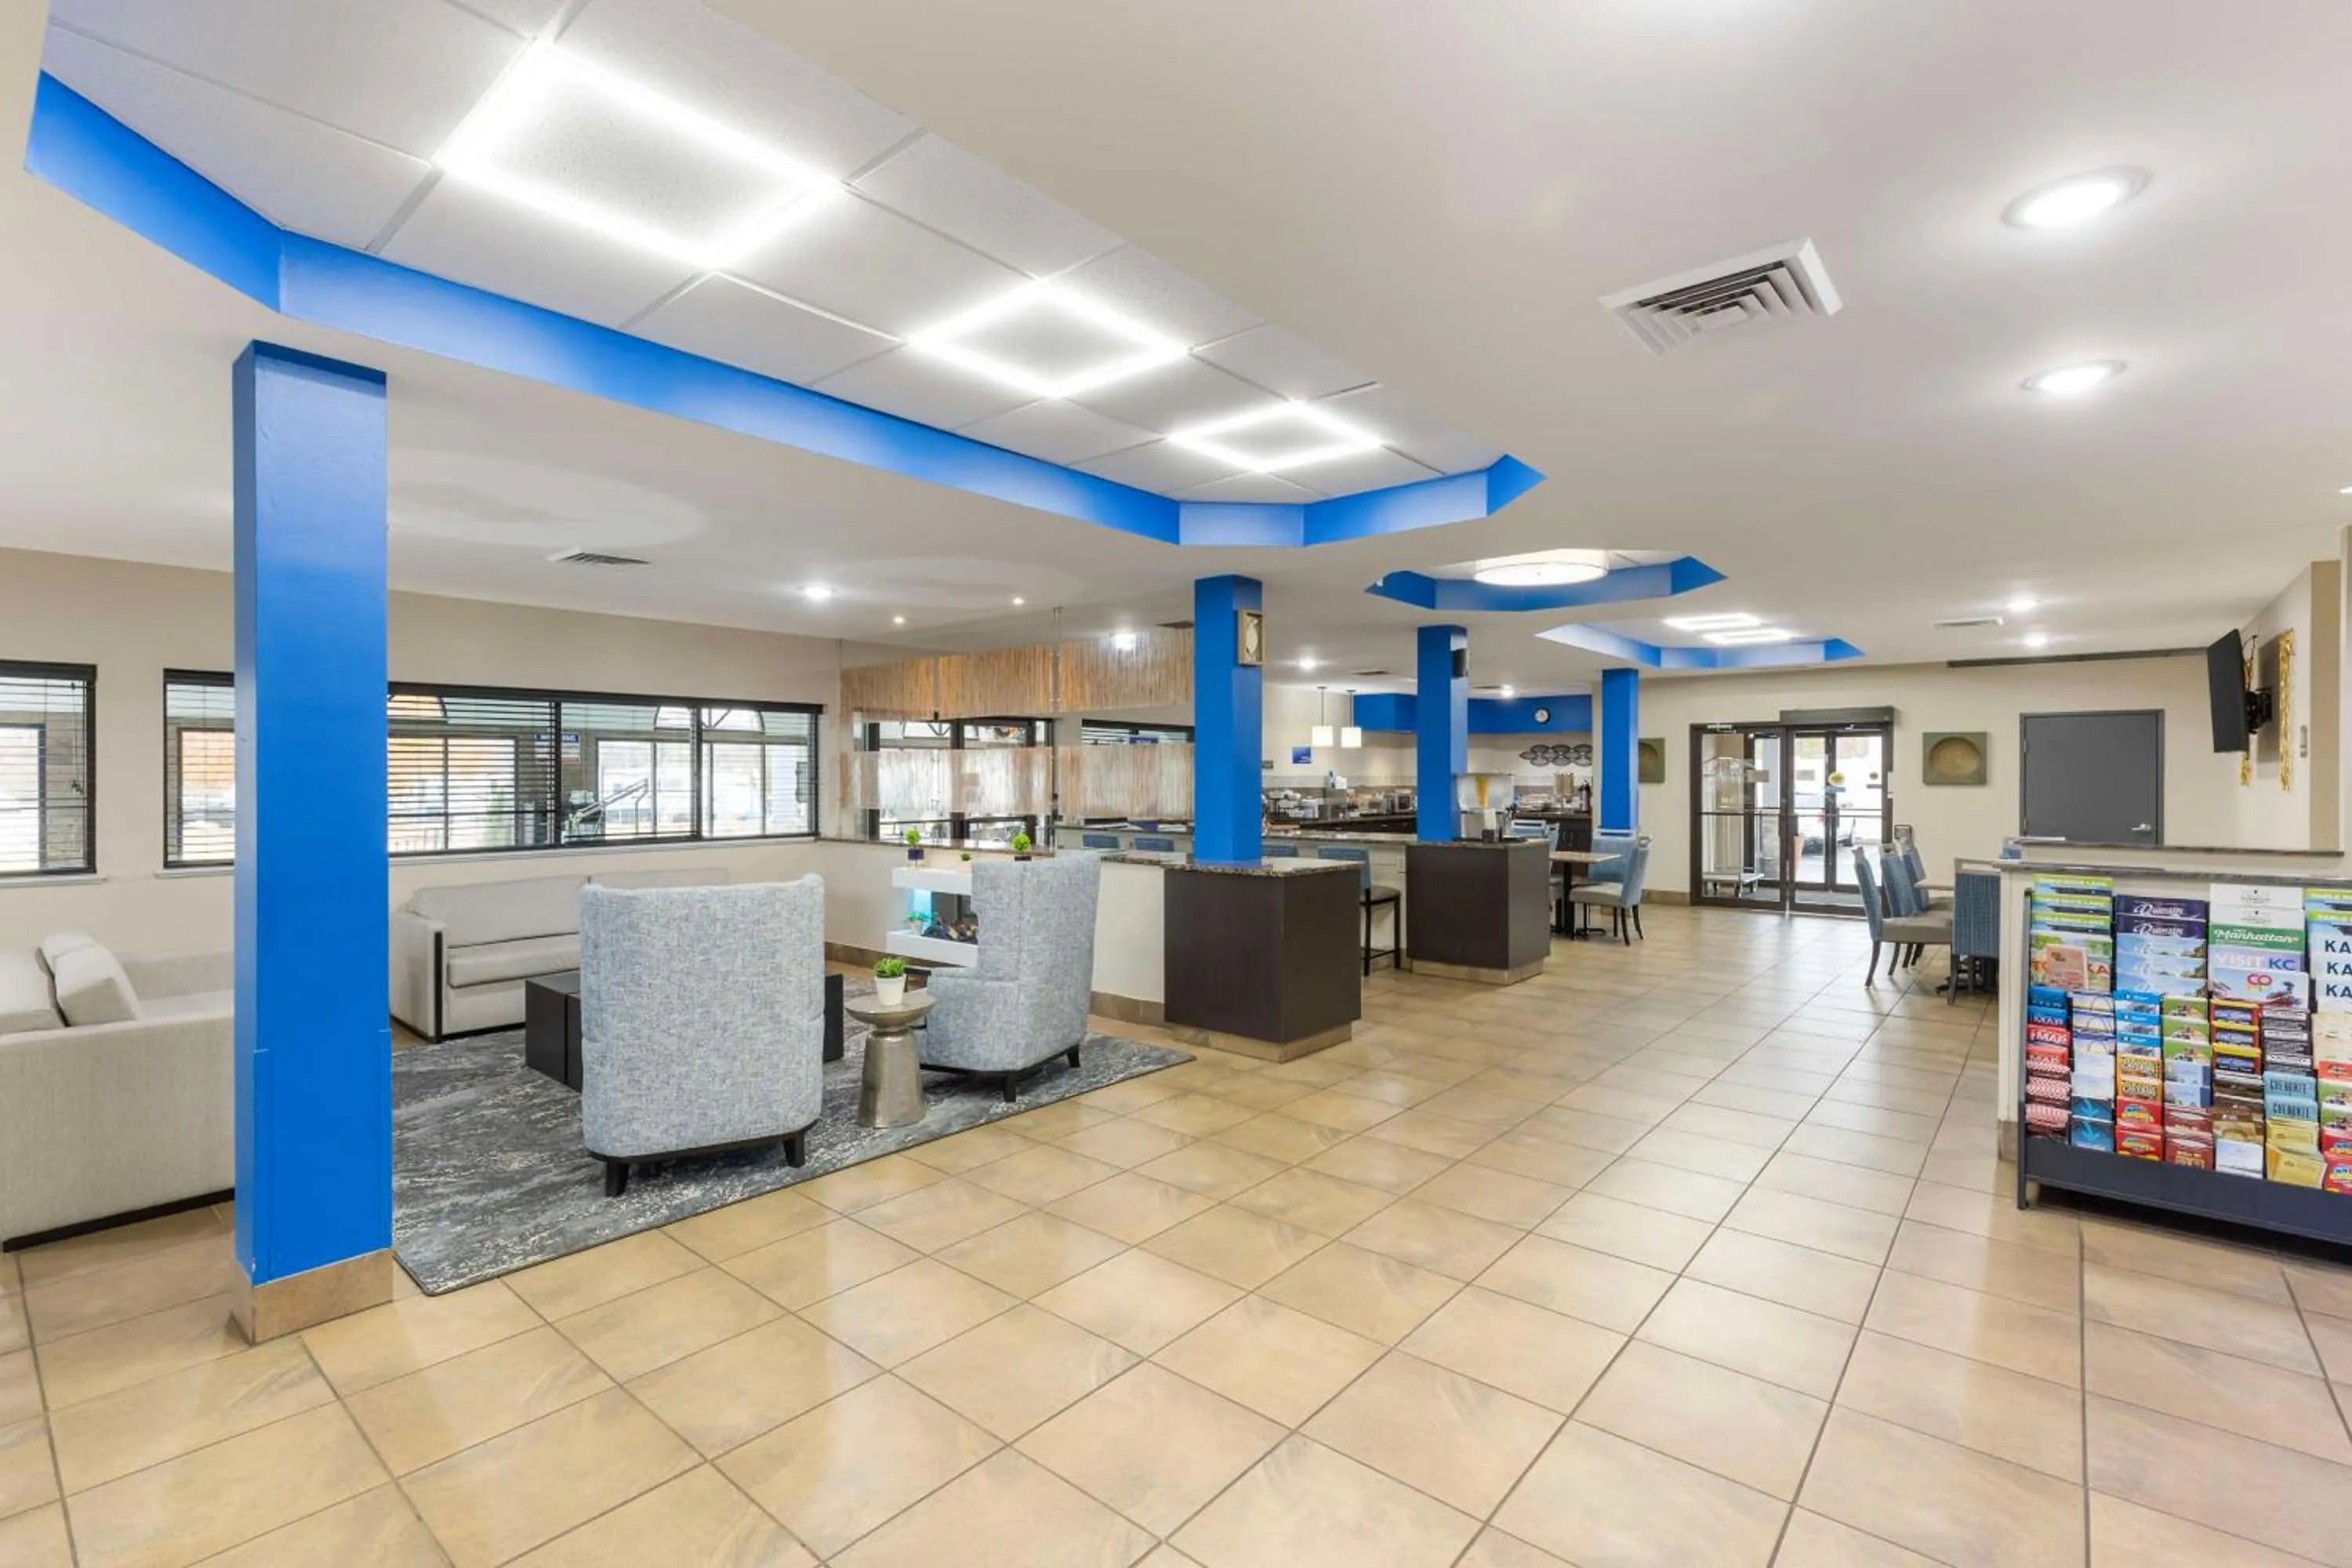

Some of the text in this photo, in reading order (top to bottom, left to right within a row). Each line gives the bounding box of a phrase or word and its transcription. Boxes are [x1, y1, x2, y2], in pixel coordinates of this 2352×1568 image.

[2214, 928, 2292, 943] Manhattan
[2215, 951, 2296, 971] VISIT KC
